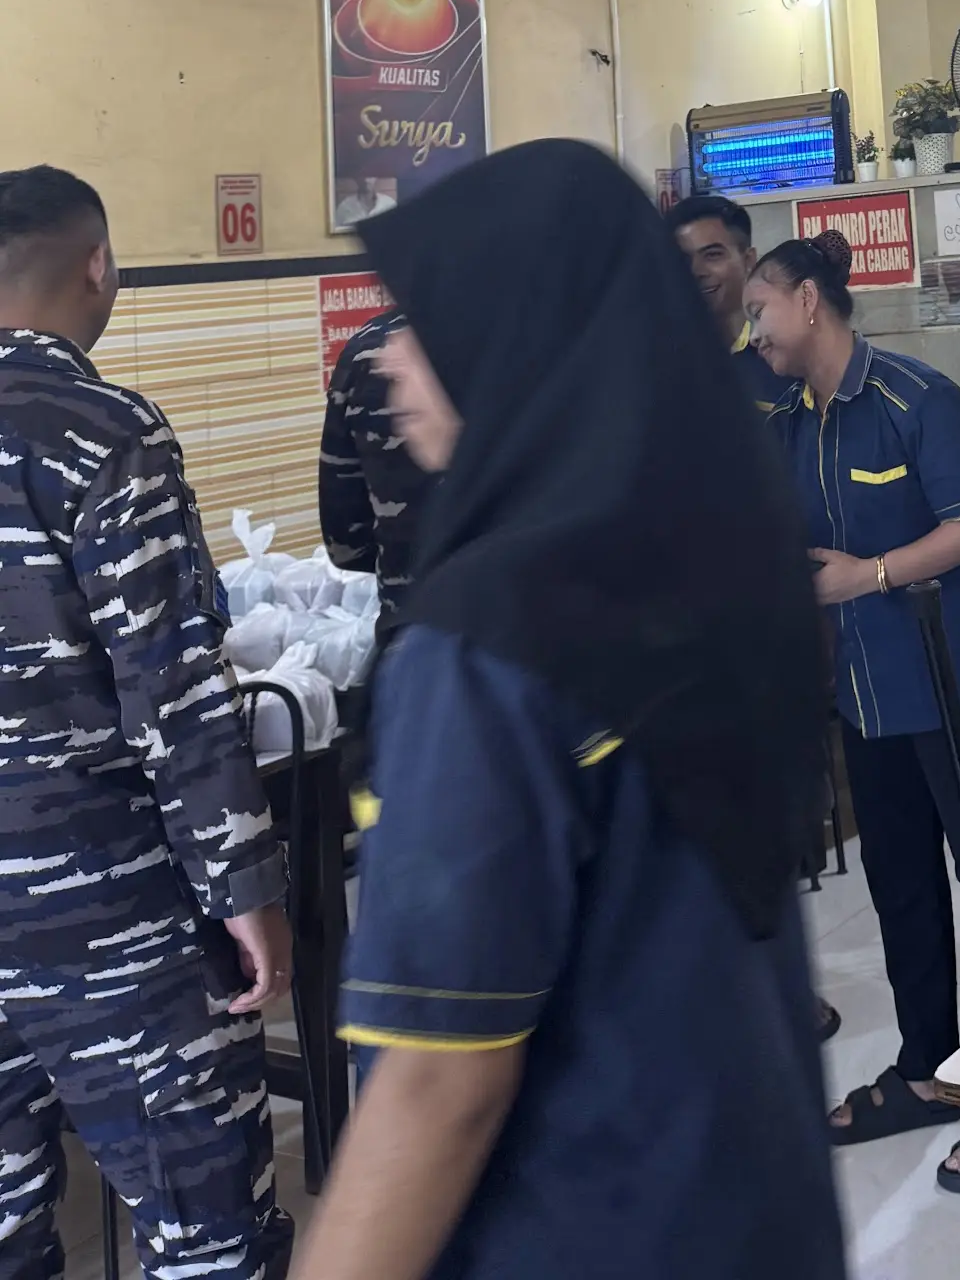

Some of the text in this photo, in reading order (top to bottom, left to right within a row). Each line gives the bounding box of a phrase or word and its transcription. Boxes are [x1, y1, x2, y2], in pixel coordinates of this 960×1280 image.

[378, 66, 441, 87] KUALITAS
[358, 104, 466, 167] Surya
[222, 202, 257, 244] 06
[868, 206, 908, 245] PERAK
[867, 246, 910, 273] CABANG
[322, 288, 346, 313] JAGA
[347, 284, 382, 310] BARANG
